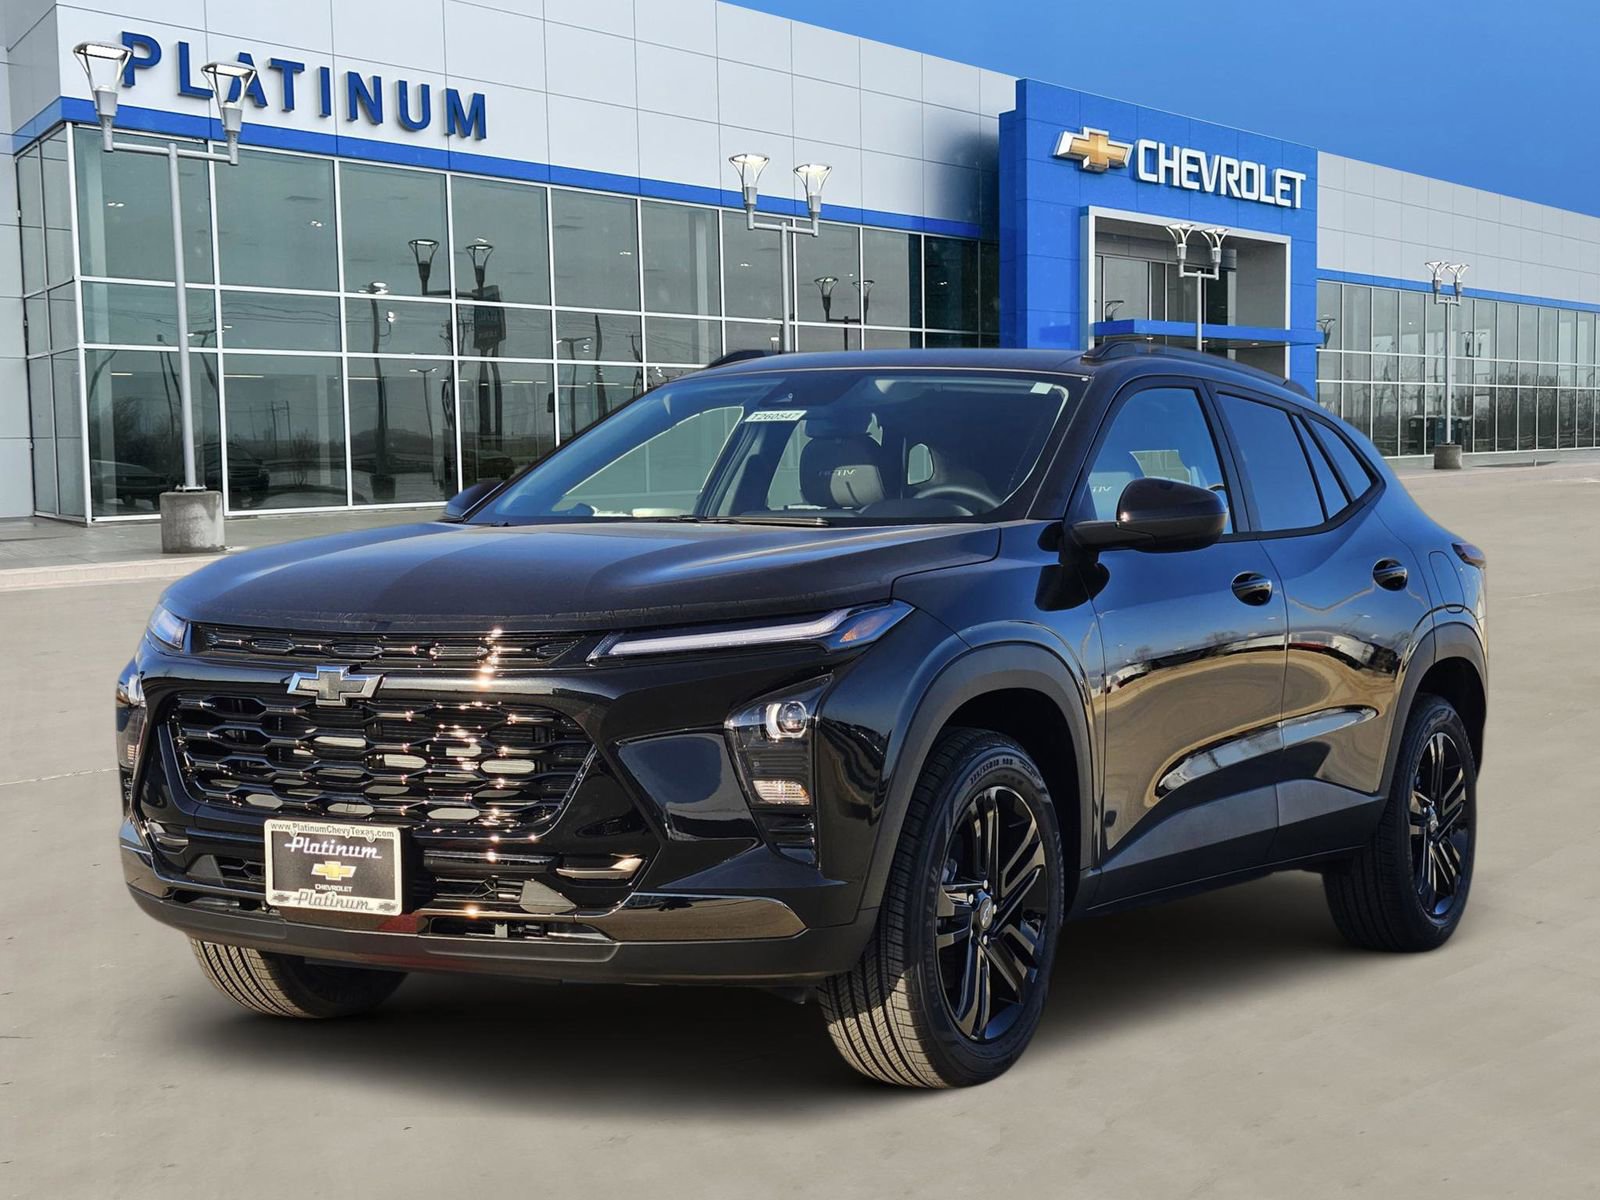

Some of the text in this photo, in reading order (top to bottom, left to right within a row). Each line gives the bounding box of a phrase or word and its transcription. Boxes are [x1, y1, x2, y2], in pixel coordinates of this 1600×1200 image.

[120, 31, 487, 141] PLATINUM
[1136, 138, 1307, 209] CHEVROLET
[270, 822, 395, 838] www.PlatinumChevyTexas.com
[284, 836, 382, 859] Platinum
[314, 883, 353, 892] CHEVROLET
[293, 891, 374, 911] Platinum
